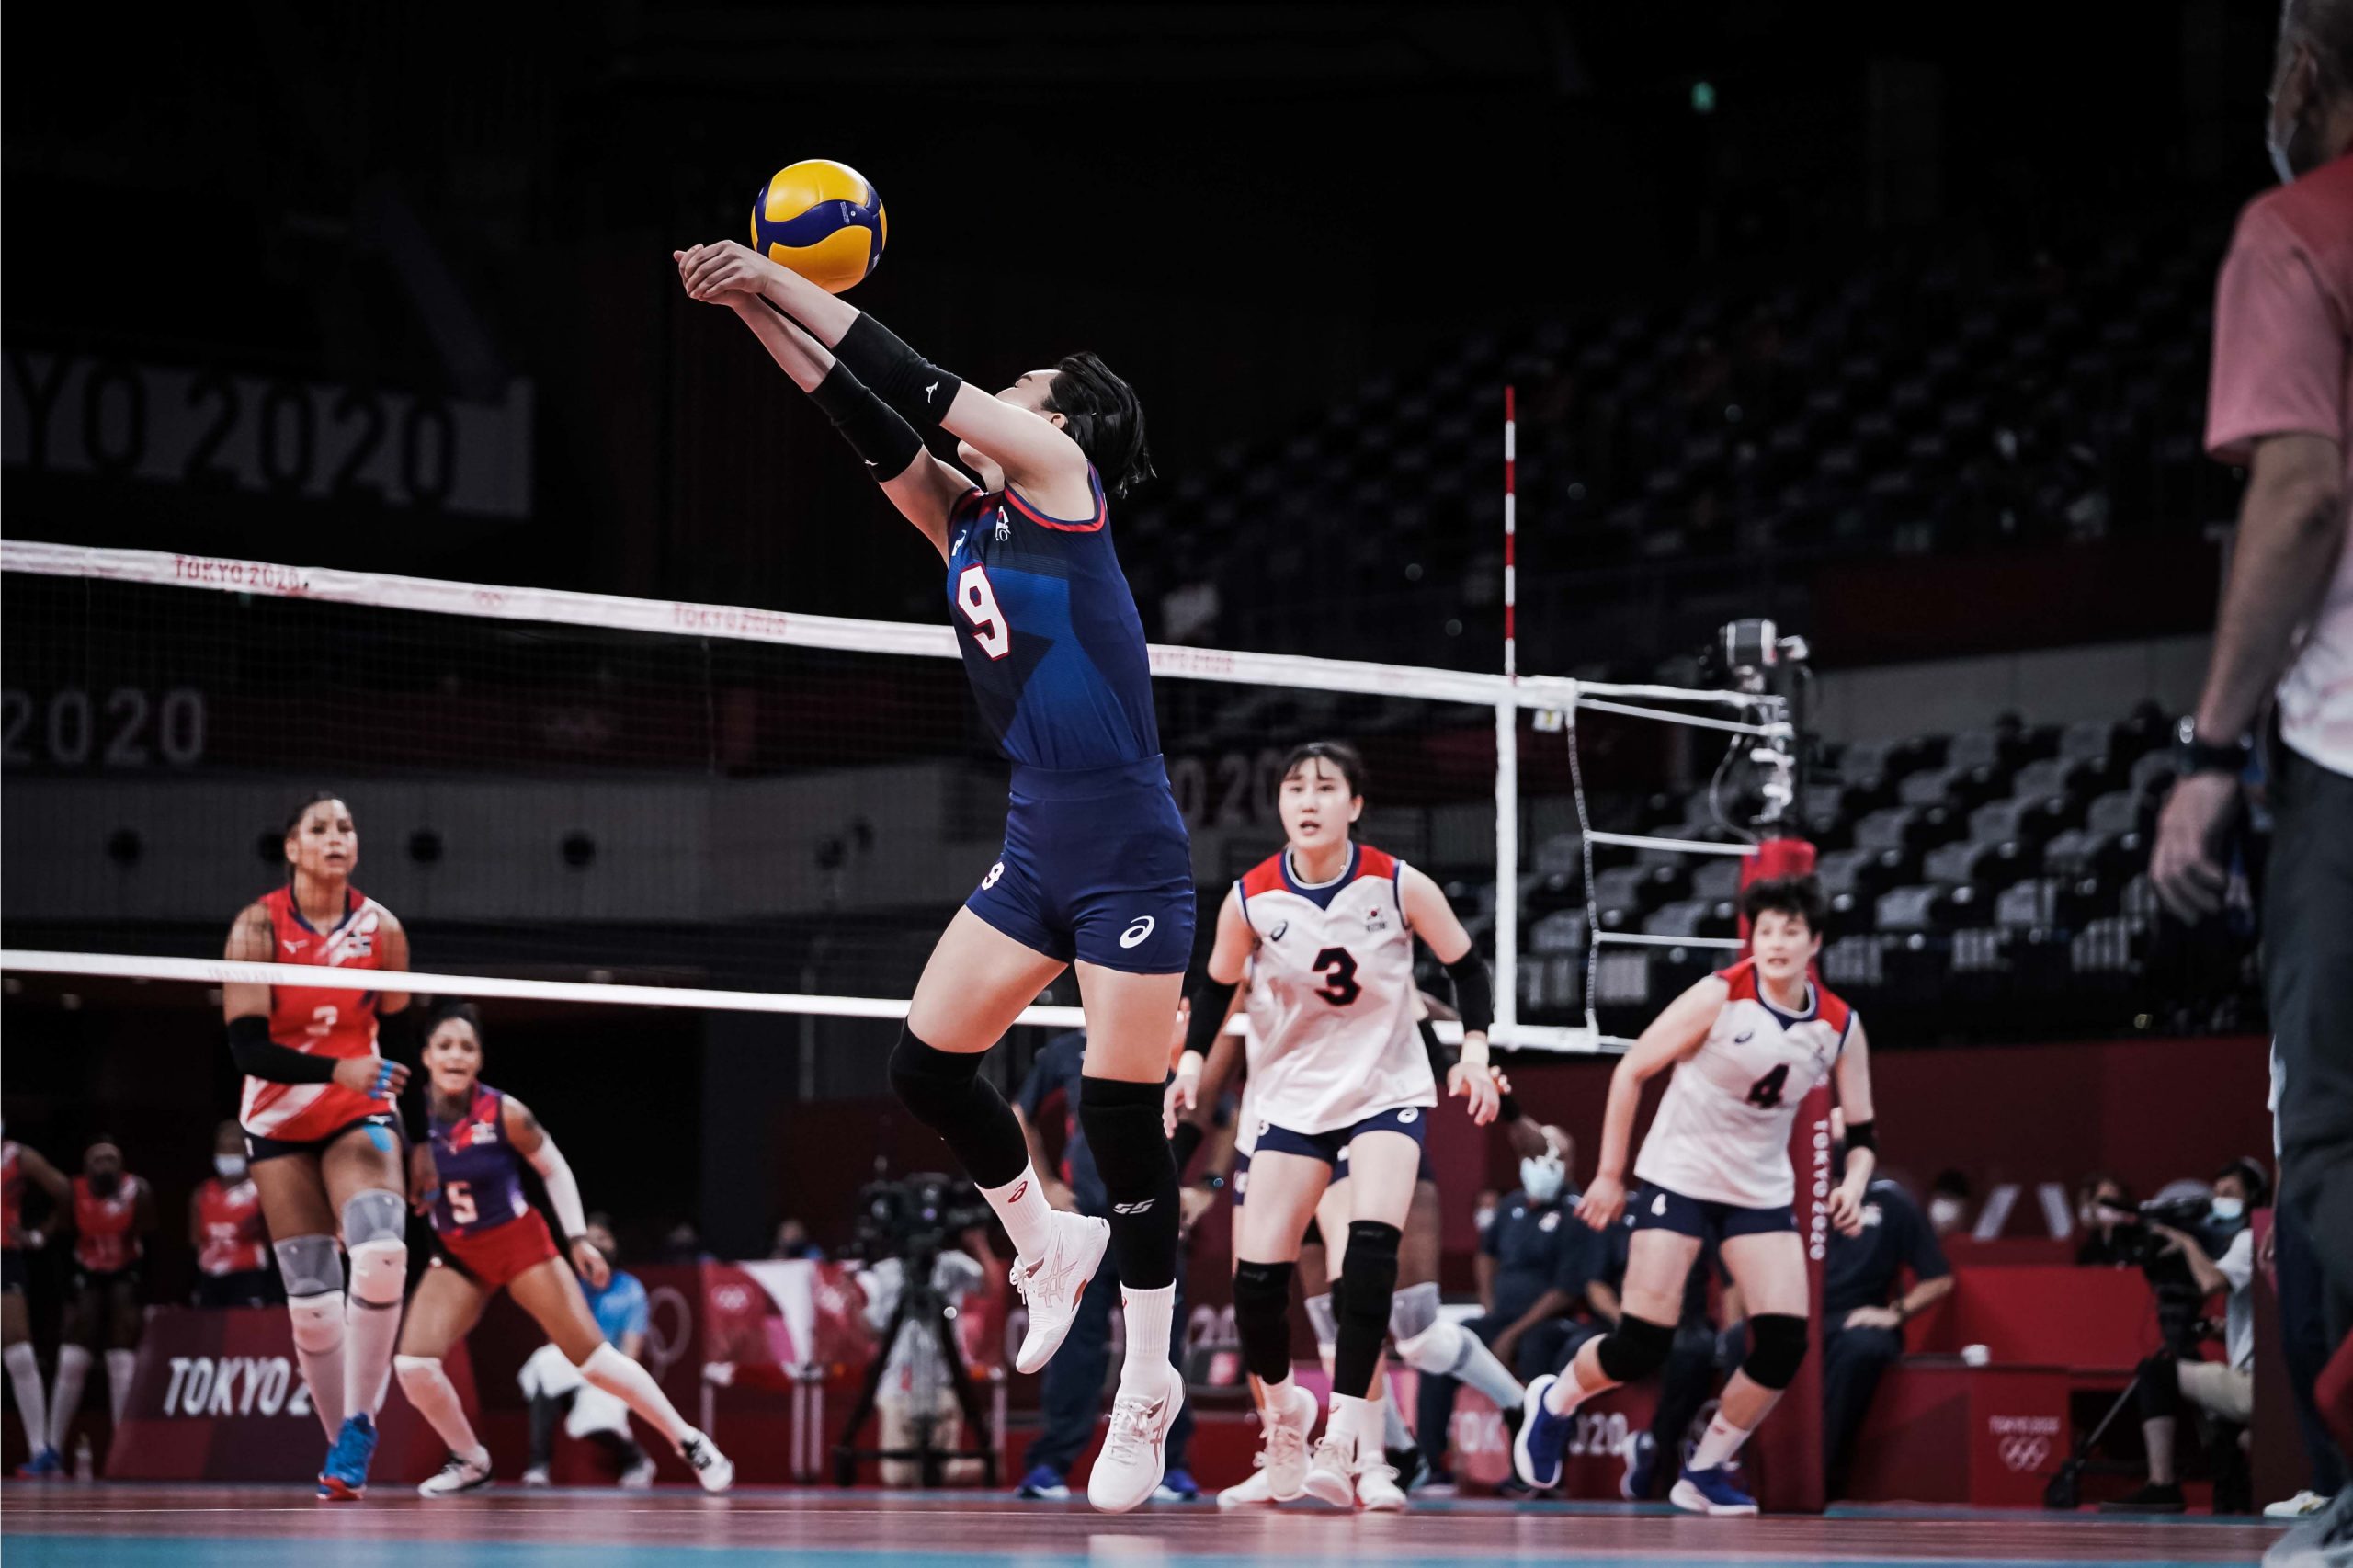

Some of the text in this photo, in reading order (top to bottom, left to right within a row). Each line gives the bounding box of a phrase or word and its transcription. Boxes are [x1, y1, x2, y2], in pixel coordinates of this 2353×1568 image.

[183, 366, 454, 501] 2020
[174, 556, 243, 583] TOKYO
[957, 562, 1012, 662] 9
[2, 687, 205, 767] 2020
[1313, 947, 1361, 1006] 3
[1748, 1064, 1790, 1108] 4
[445, 1180, 479, 1224] 5
[1809, 1118, 1830, 1260] TOKYO 2020
[163, 1356, 291, 1416] TOKYO
